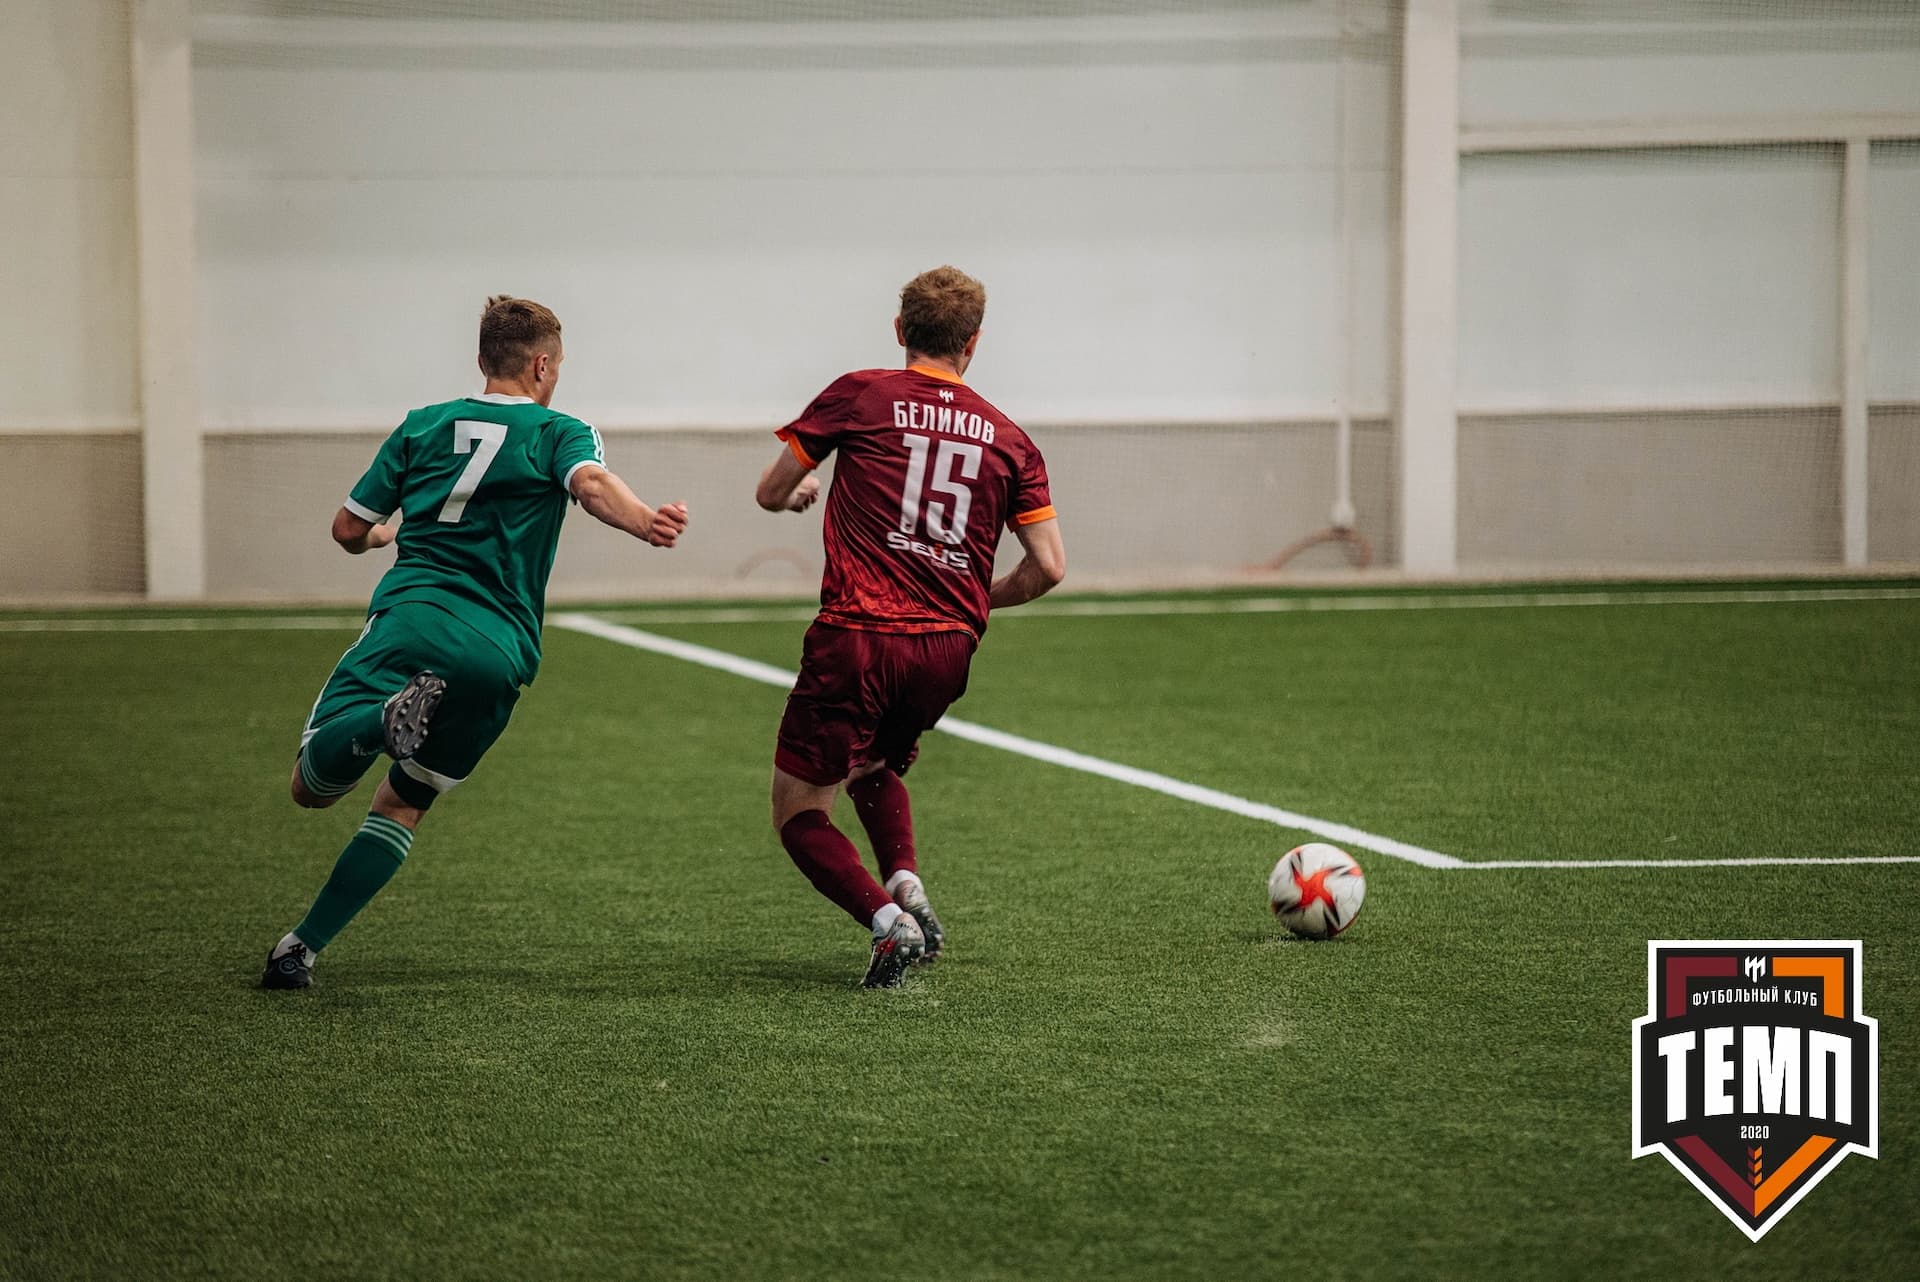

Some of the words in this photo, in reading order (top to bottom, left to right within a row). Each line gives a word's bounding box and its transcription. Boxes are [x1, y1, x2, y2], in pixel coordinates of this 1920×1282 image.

[437, 420, 508, 523] 7
[893, 401, 996, 445] БЕЛИКОВ
[899, 433, 983, 545] 15
